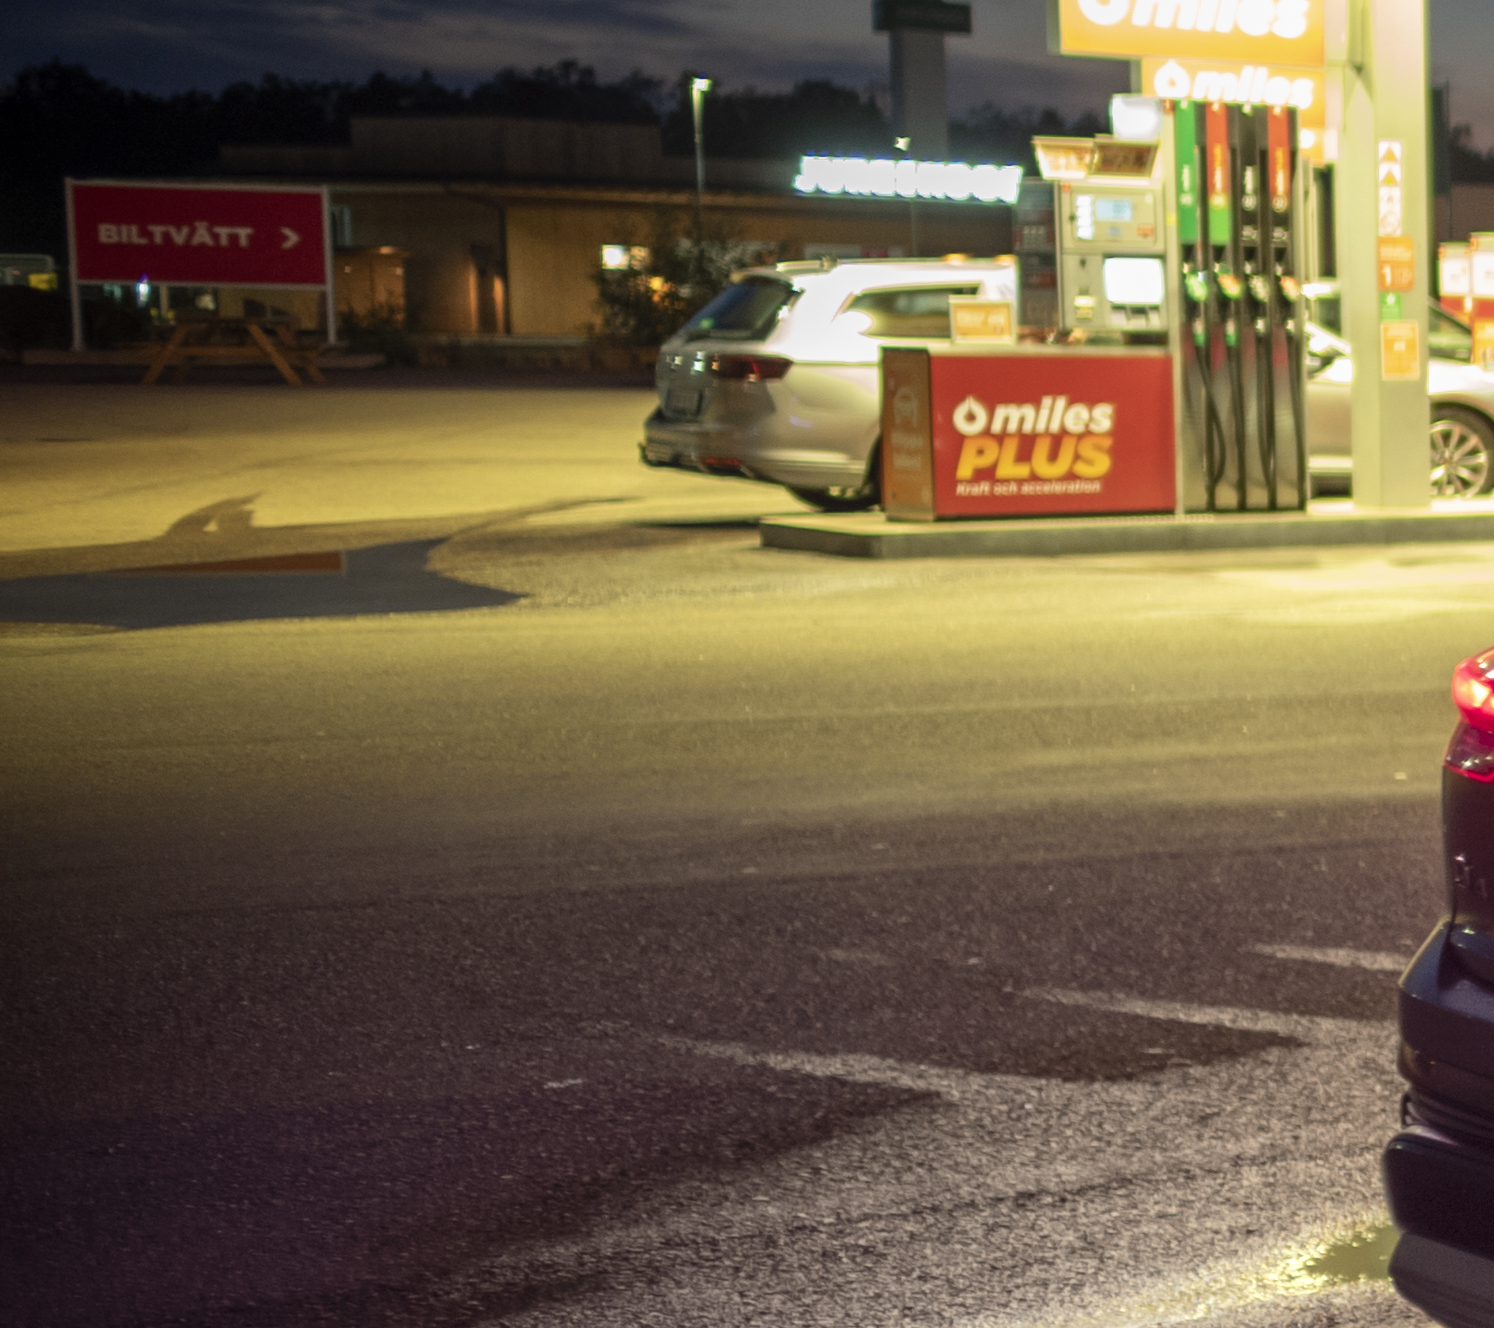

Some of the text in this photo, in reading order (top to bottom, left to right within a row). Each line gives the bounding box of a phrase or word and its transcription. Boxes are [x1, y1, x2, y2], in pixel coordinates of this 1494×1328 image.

[1191, 64, 1315, 110] miles
[990, 394, 1115, 435] miles
[955, 434, 1114, 481] PLUS
